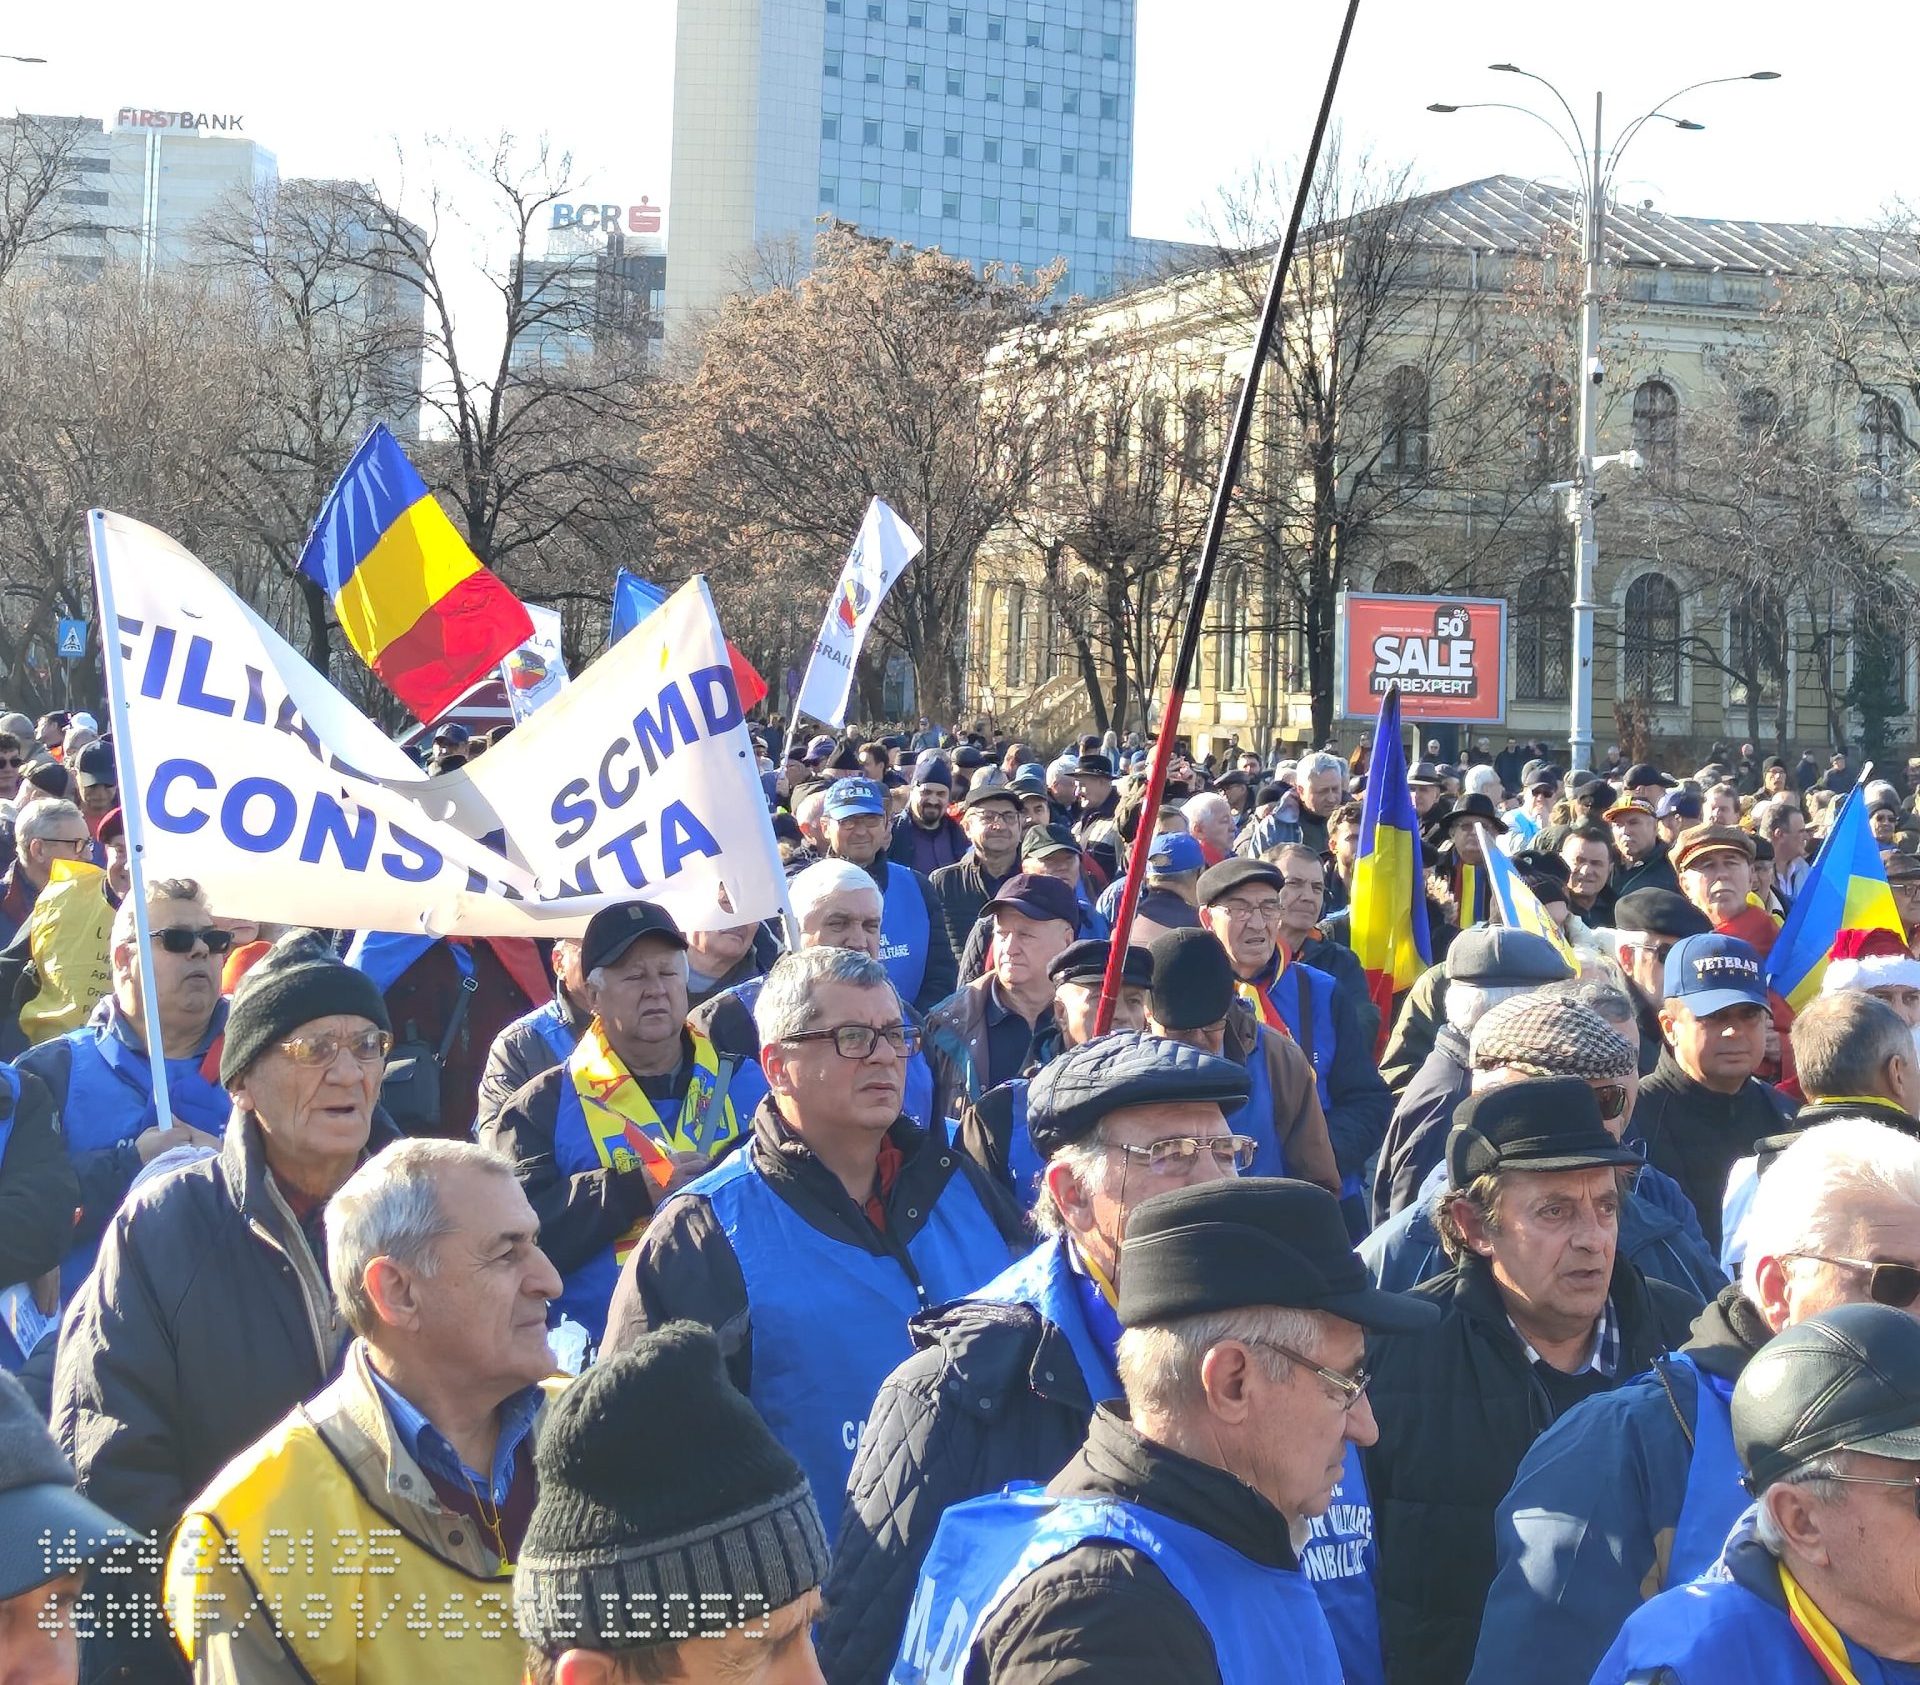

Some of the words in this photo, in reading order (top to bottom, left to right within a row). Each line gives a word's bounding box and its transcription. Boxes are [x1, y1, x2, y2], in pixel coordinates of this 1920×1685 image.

[553, 203, 624, 235] BCR
[1374, 636, 1474, 677] SALE
[551, 664, 744, 848] SCMD
[1693, 956, 1759, 973] VETERAN
